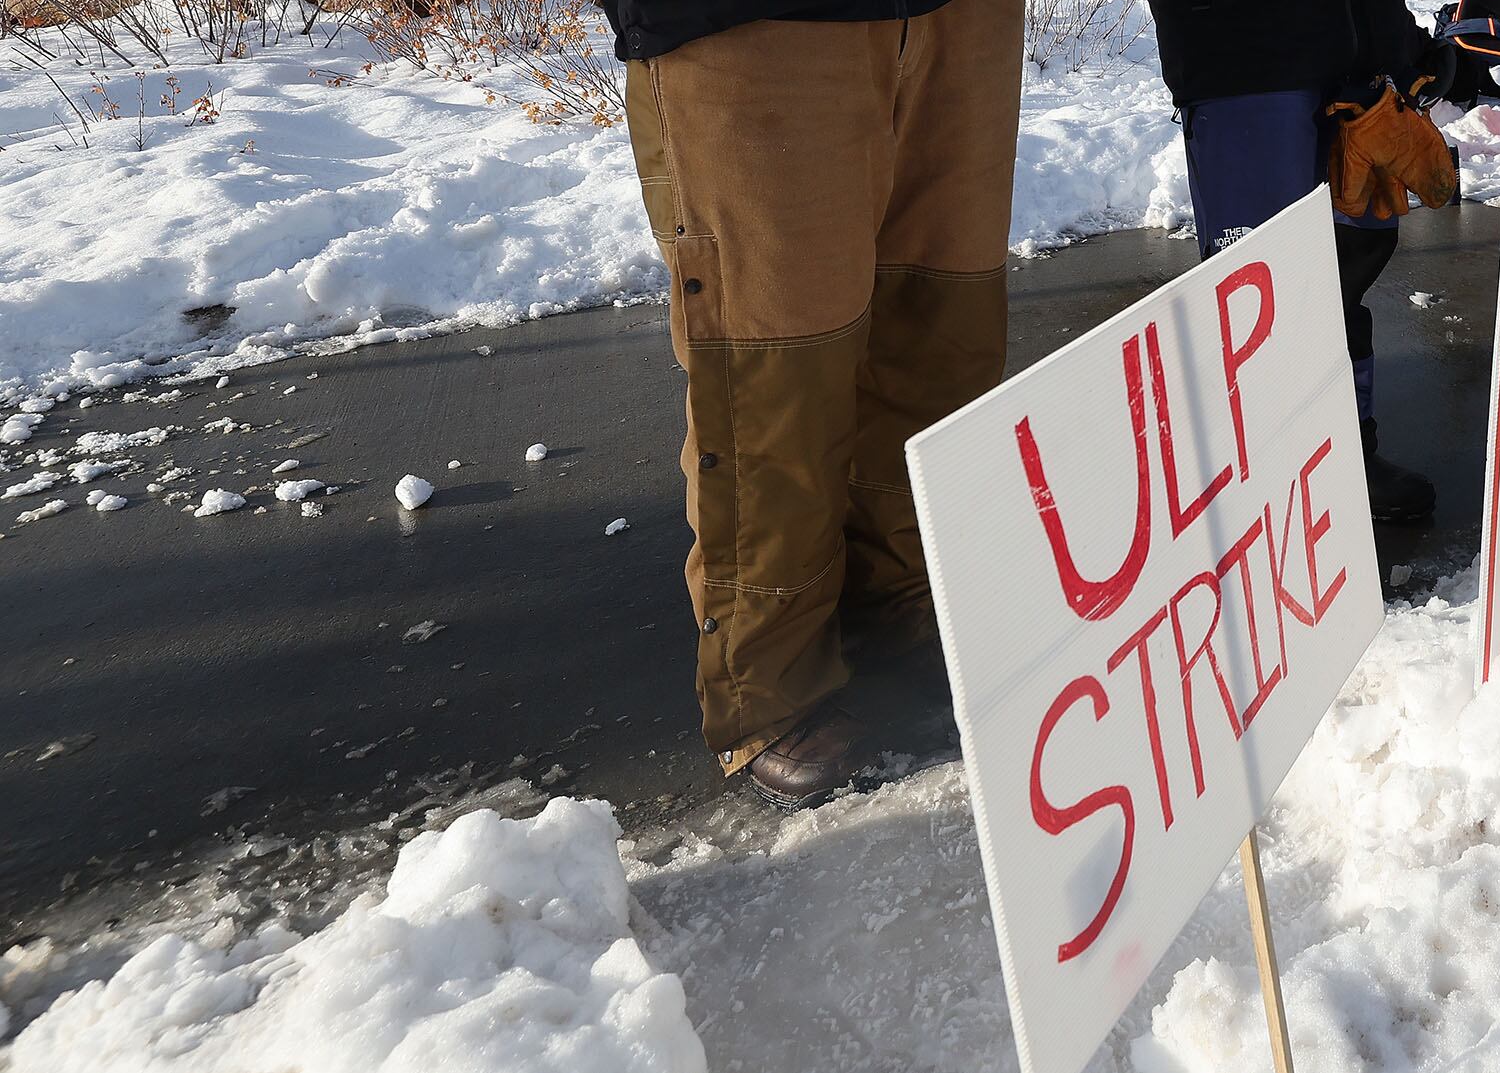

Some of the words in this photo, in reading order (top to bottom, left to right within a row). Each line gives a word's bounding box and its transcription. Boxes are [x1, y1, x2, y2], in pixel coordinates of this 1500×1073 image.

[1214, 236, 1243, 247] NORT
[1223, 227, 1242, 237] THE
[1013, 259, 1276, 622] ULP
[1029, 436, 1348, 964] STRIKE
